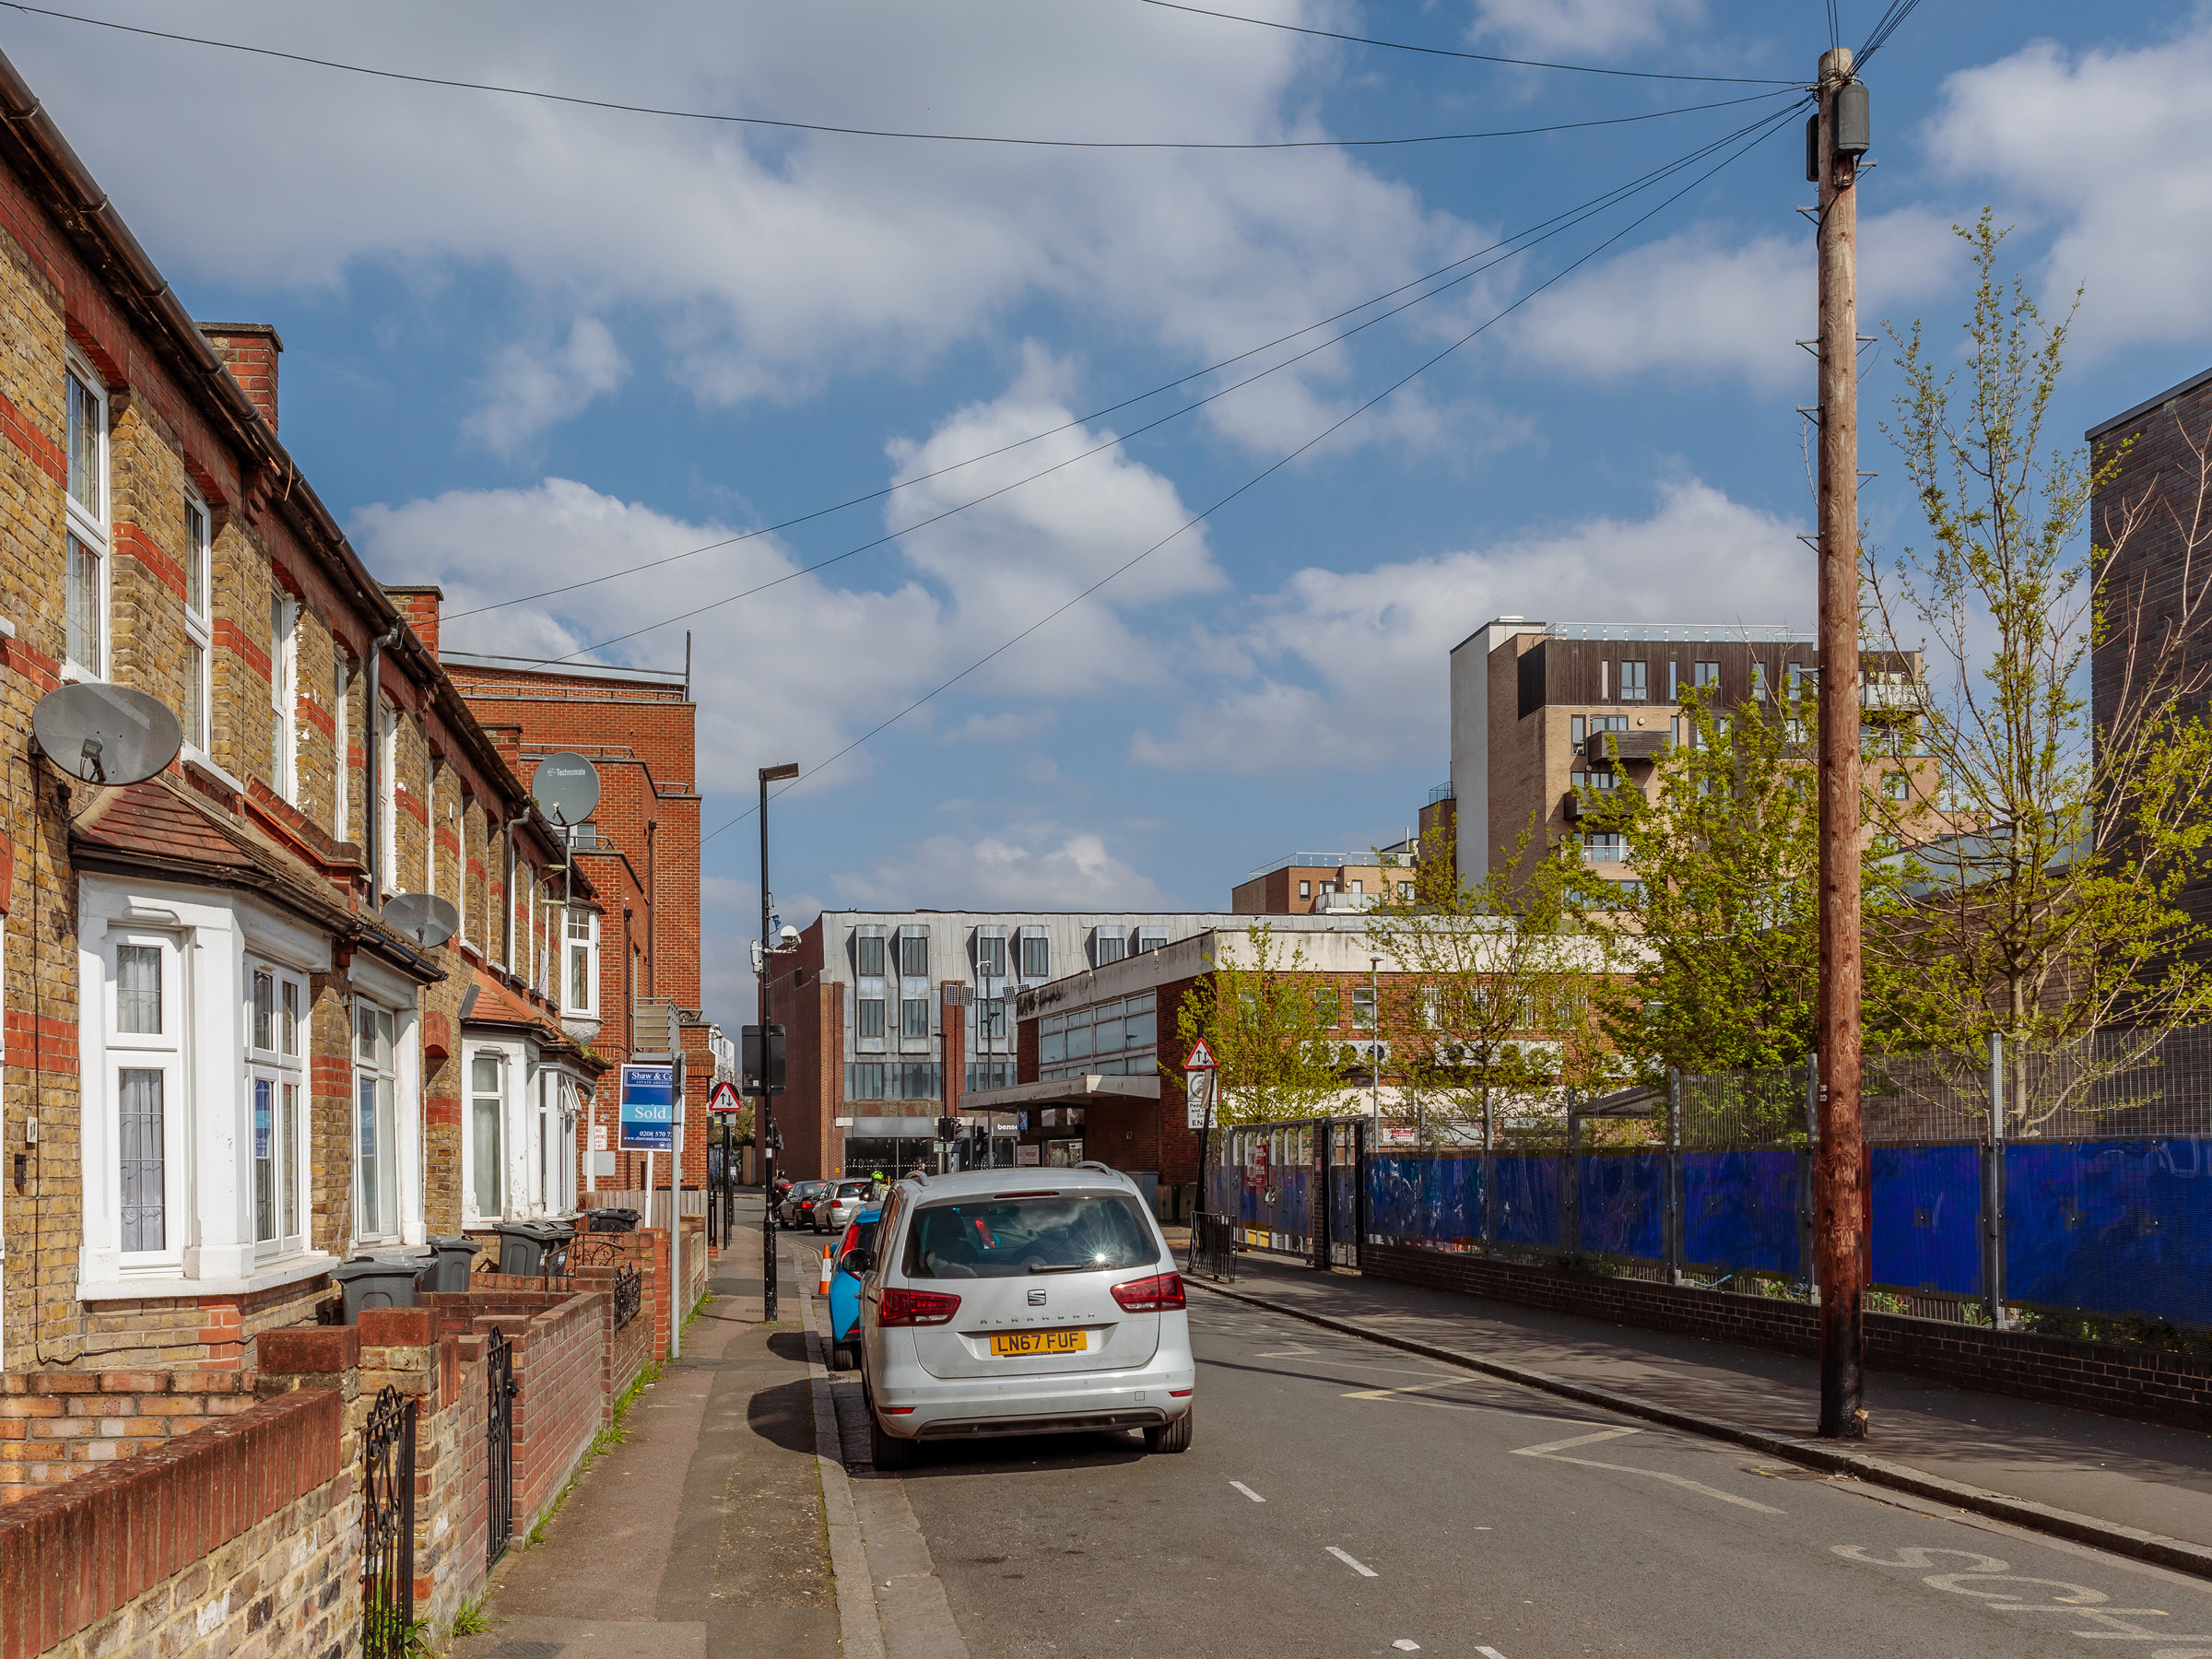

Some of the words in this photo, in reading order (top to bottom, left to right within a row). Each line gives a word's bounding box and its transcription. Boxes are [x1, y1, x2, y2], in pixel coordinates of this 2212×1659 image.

[556, 768, 586, 776] Technomate
[635, 1107, 666, 1119] Sold
[997, 1334, 1041, 1352] LN67
[1047, 1333, 1078, 1349] FUF
